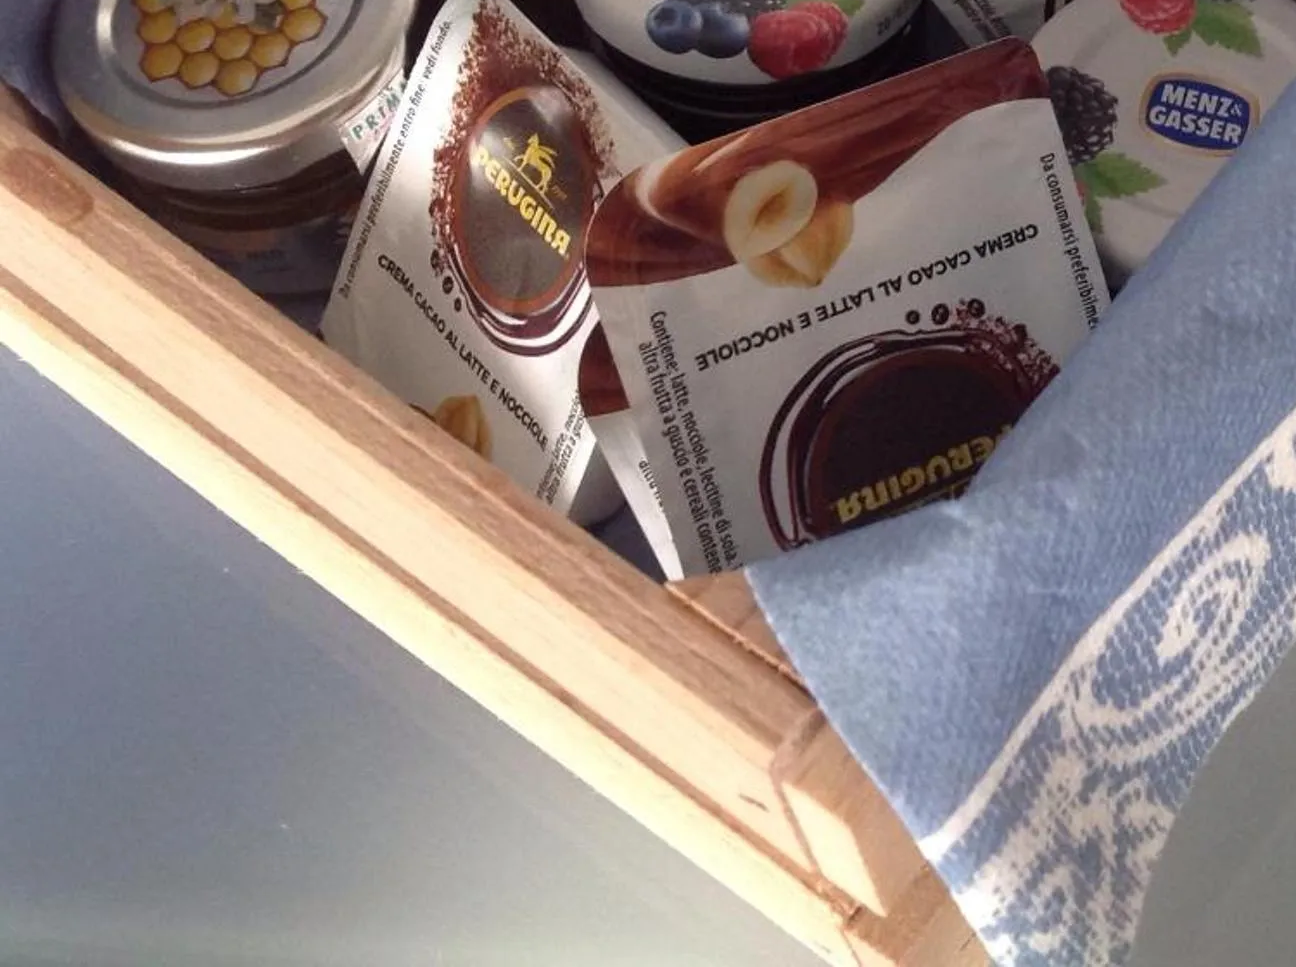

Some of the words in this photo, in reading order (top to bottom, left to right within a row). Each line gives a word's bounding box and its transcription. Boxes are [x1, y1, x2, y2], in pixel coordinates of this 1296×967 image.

[1149, 105, 1242, 144] GASSER
[367, 137, 405, 226] preferibilmente
[400, 109, 418, 139] entro
[1040, 152, 1055, 172] Da
[470, 138, 572, 257] PERUGINA
[1046, 172, 1075, 246] consumarsi
[908, 249, 971, 279] CACAO
[974, 223, 1040, 260] CREMA
[815, 290, 874, 321] LATTE
[878, 274, 902, 298] AL
[695, 318, 795, 371] NOCCIOLE
[799, 313, 812, 330] E
[378, 253, 414, 299] CREMA
[414, 291, 445, 334] CACAO
[444, 330, 460, 352] AL
[458, 344, 490, 385] LATTE
[489, 378, 499, 394] E
[498, 387, 549, 453] NOCCIOLE
[650, 311, 679, 375] Contiene:
[701, 466, 725, 525] lecitine
[714, 520, 732, 537] di
[638, 341, 659, 374] altra
[651, 372, 672, 414] frutta
[662, 423, 688, 470] guscio
[684, 476, 708, 522] cereali
[697, 521, 723, 575] contene
